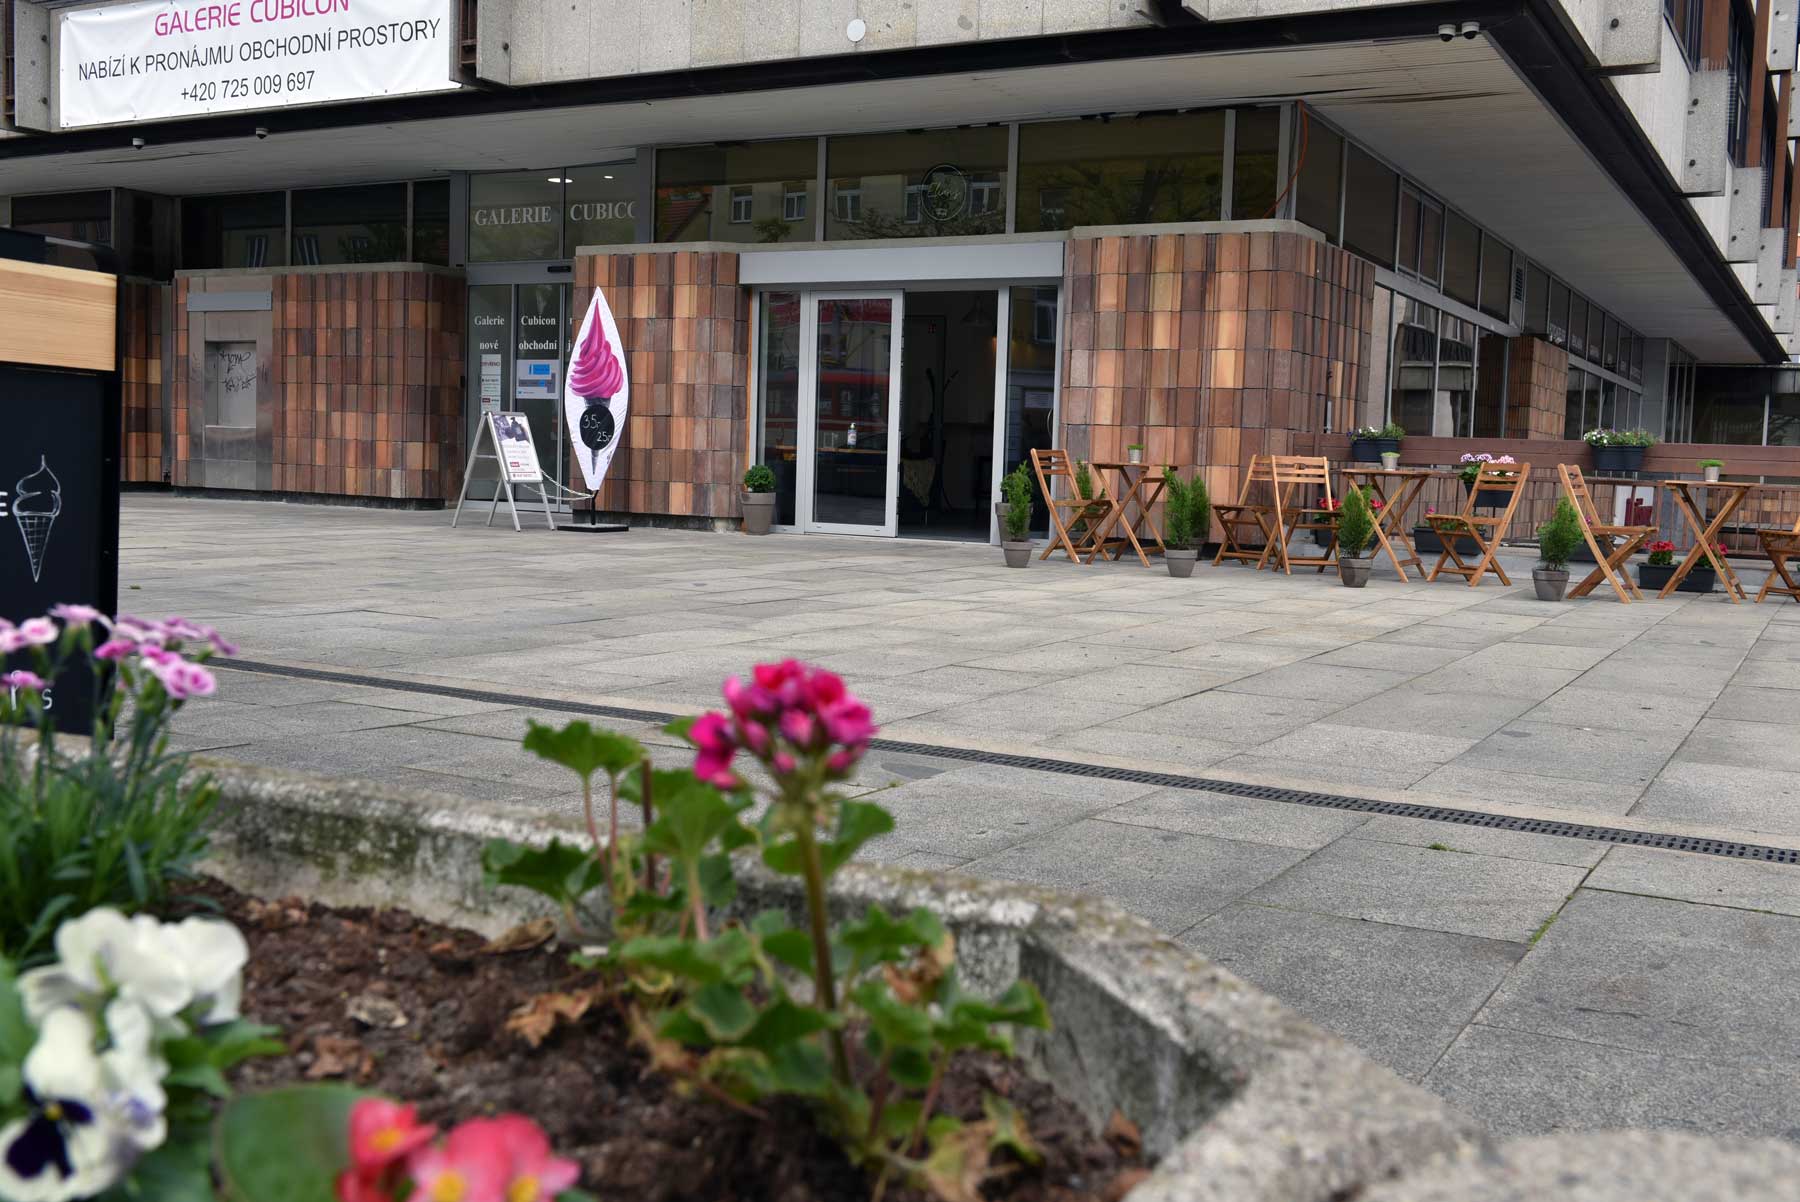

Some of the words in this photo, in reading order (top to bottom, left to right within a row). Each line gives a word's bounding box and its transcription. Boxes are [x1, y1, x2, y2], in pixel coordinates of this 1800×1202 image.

[154, 2, 241, 37] GALERIE
[250, 0, 349, 23] CUBICON
[78, 54, 126, 81] NABÍZÍ
[130, 56, 141, 75] K
[145, 44, 234, 73] PRONÁJMU
[239, 27, 332, 62] OBCHODNÍ
[337, 17, 441, 50] PROSTORY
[181, 81, 216, 102] +420
[221, 78, 249, 99] 725
[253, 73, 282, 96] 009
[286, 70, 316, 92] 697
[474, 206, 552, 226] GALERIE
[474, 315, 505, 326] Galerie
[520, 315, 556, 326] Cubicon
[479, 340, 499, 350] nové
[518, 339, 557, 350] obchodní
